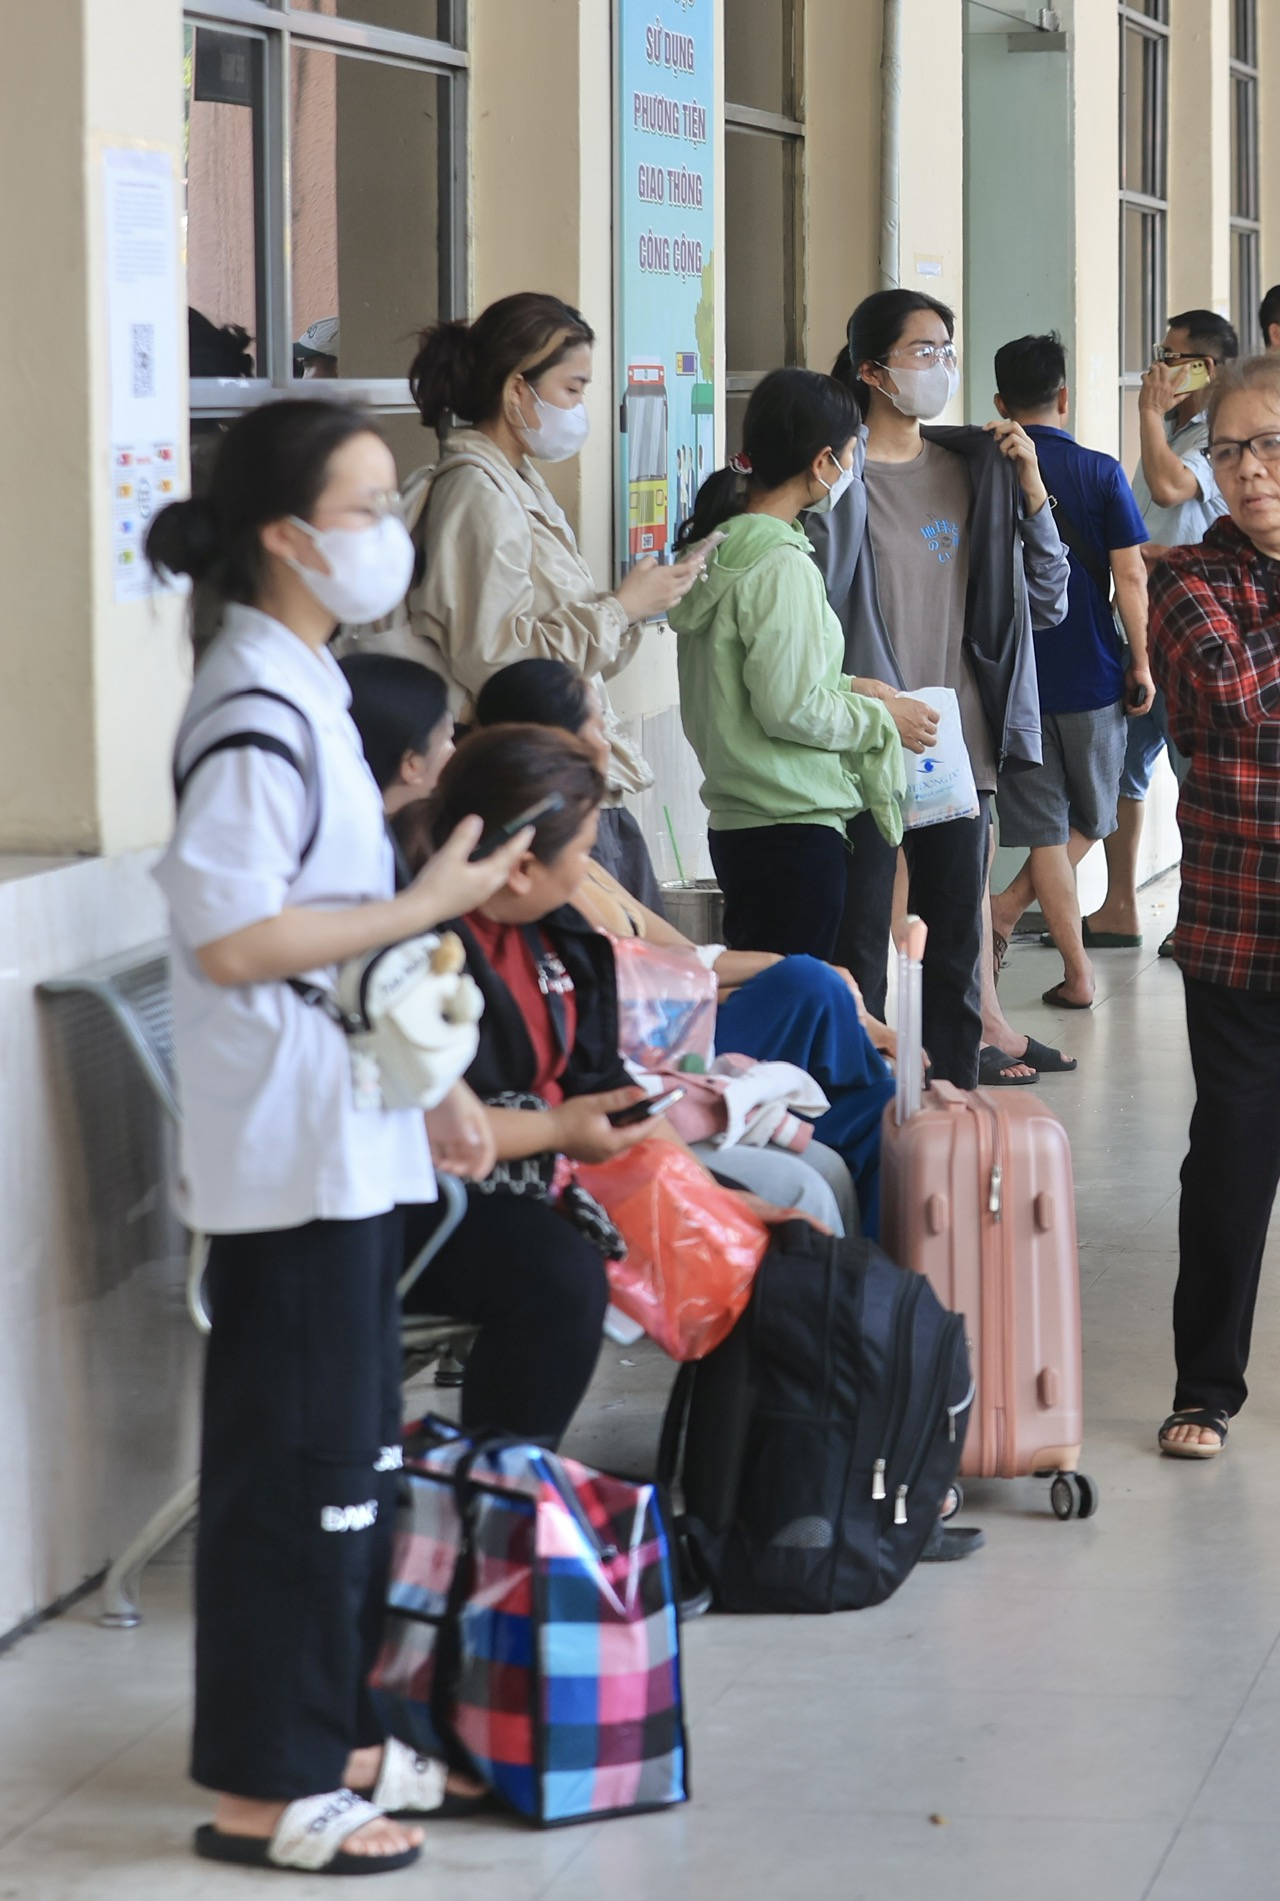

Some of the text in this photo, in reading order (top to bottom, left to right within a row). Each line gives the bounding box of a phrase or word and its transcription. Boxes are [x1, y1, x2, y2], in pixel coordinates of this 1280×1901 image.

[646, 15, 695, 78] SỬ DỤNG
[633, 91, 706, 150] PHƯƠNG TIỆN
[638, 162, 703, 211] GIAO THÔNG
[639, 227, 703, 284] CÔNG CỘNG
